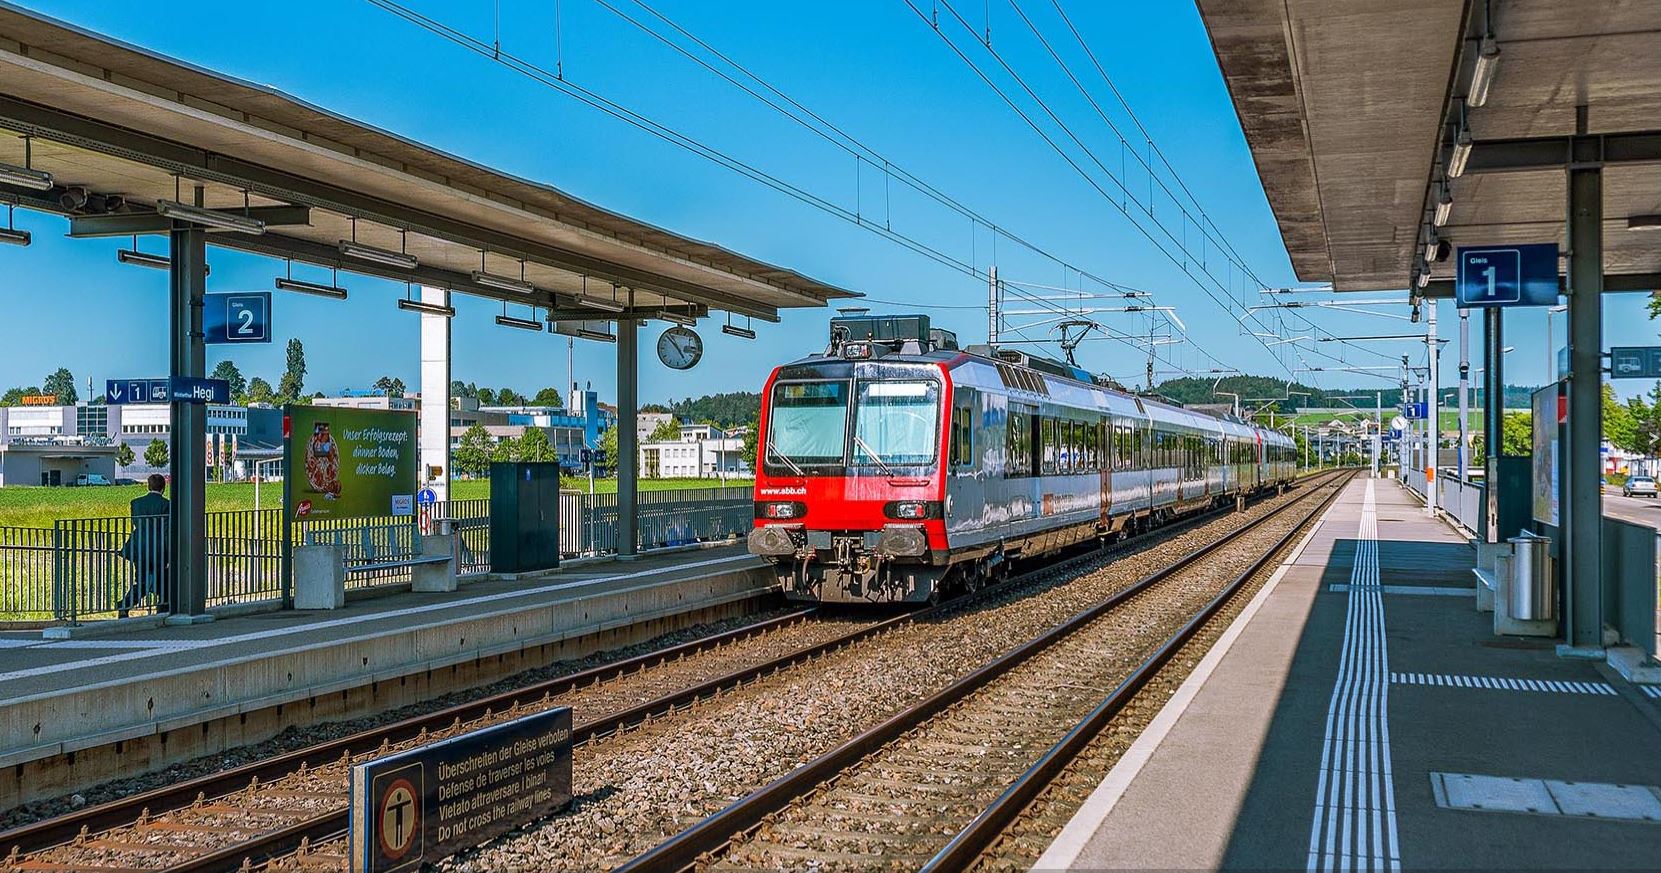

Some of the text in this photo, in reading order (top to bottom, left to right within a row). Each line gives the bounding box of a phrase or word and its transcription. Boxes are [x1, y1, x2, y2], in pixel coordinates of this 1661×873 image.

[1482, 266, 1496, 296] 1
[238, 310, 254, 334] 2
[22, 396, 56, 404] MIGROS
[134, 386, 140, 400] 1
[193, 386, 214, 403] Hegi
[342, 428, 408, 444] Unser Erfolgsrezept:
[352, 445, 378, 458] dünner
[356, 462, 378, 474] dicker
[438, 728, 569, 781] Überschreiten der Gleise verboten
[438, 750, 555, 802] Défense de traverser les voies
[438, 800, 470, 822] Vietato
[472, 782, 520, 810] attraversare
[526, 769, 547, 789] binari
[438, 788, 552, 842] Do not cross the railway lines
